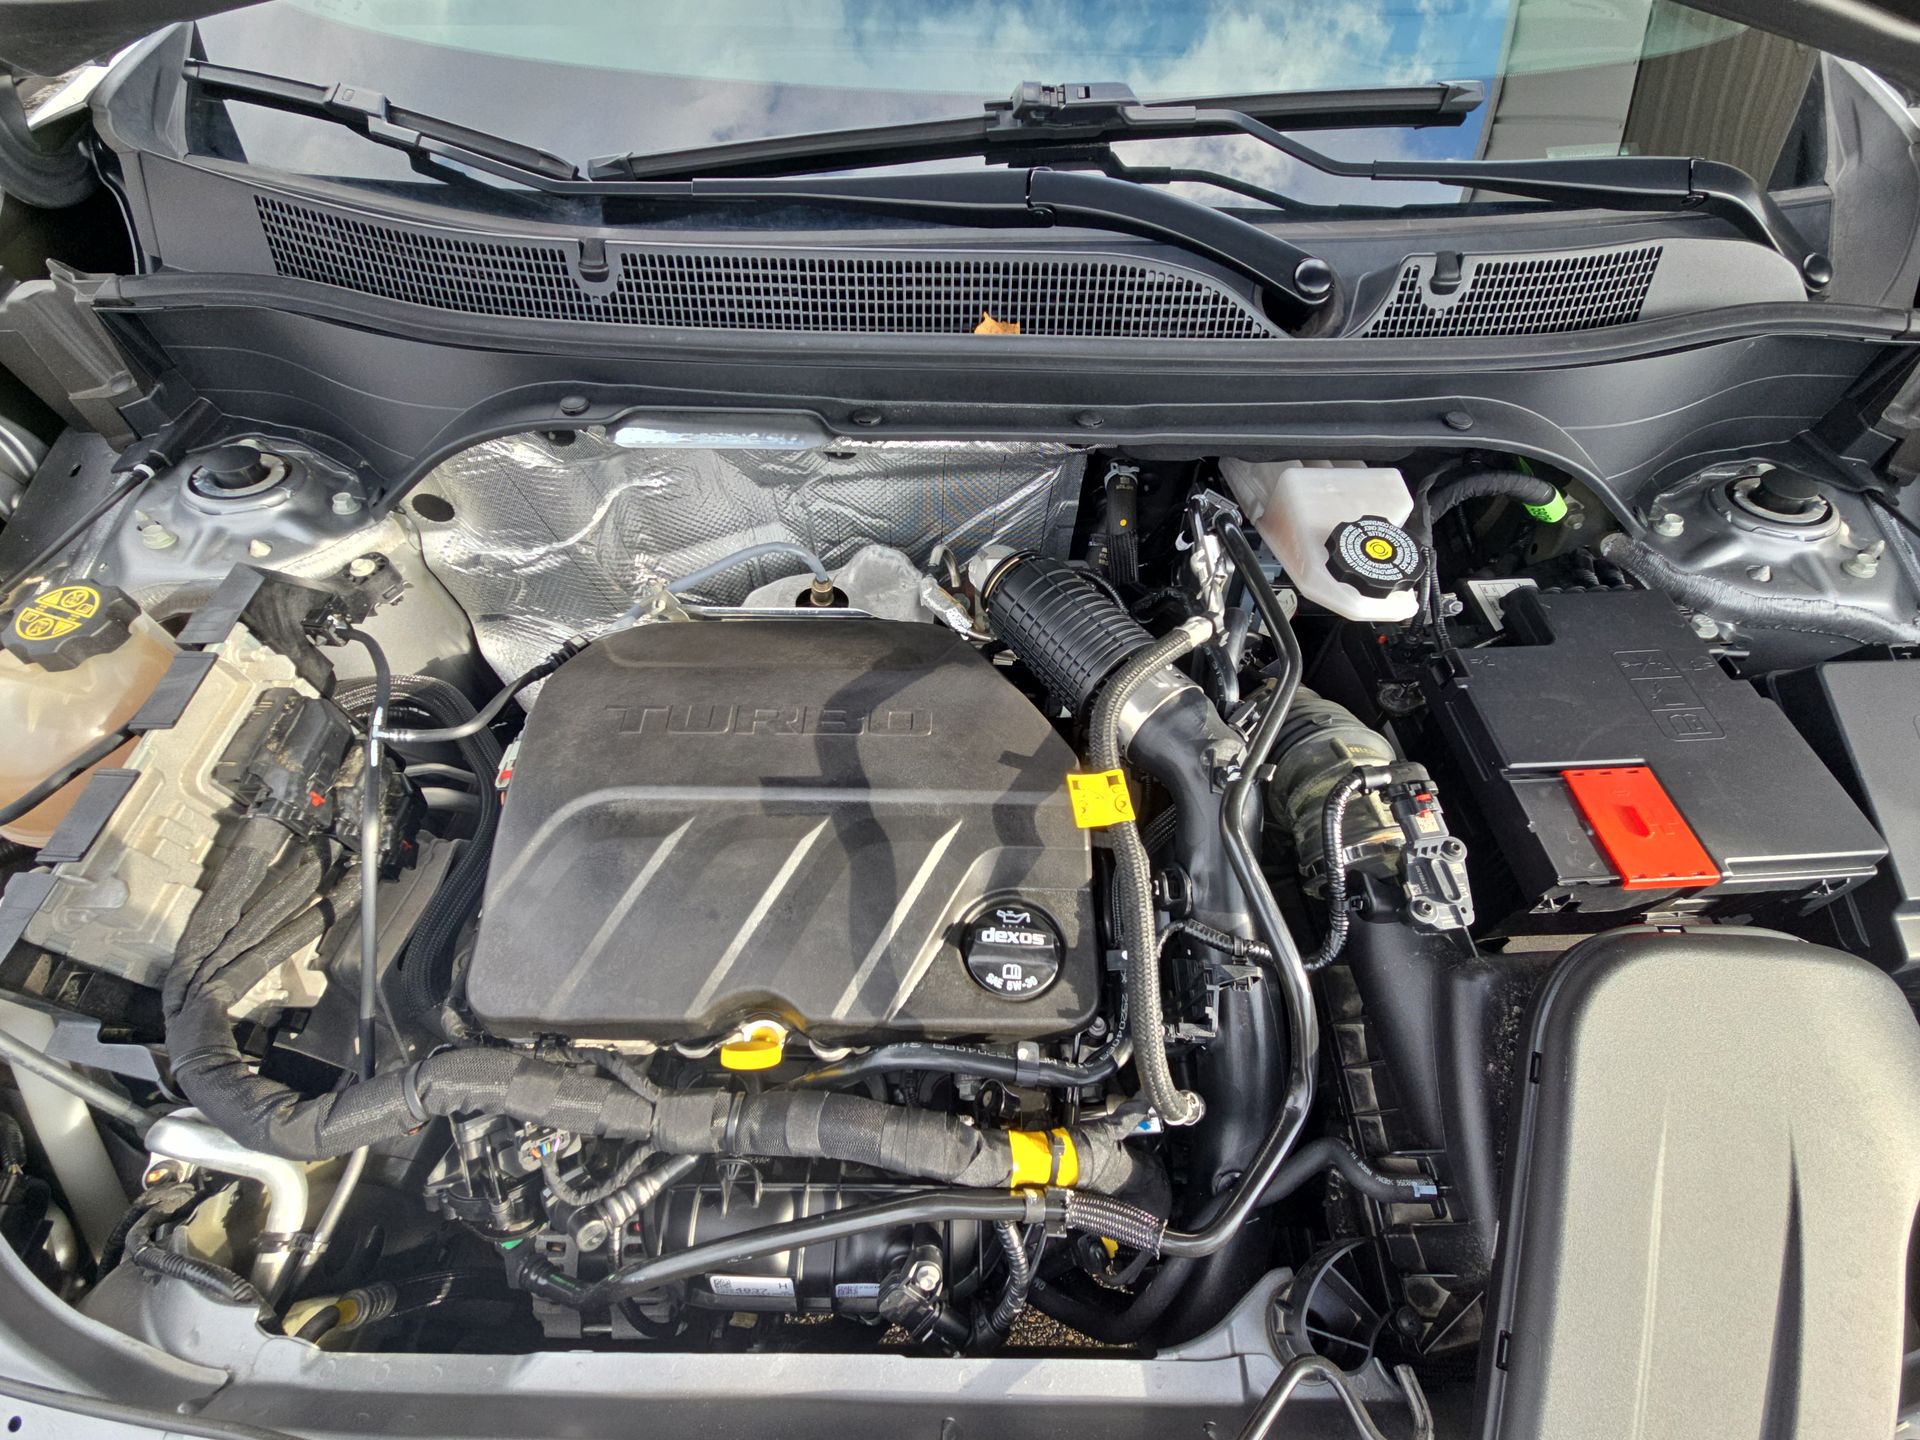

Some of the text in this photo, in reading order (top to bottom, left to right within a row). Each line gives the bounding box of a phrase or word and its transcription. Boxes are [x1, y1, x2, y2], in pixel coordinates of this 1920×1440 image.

[604, 704, 933, 737] TURBO
[981, 926, 1047, 946] dexos
[985, 973, 1038, 991] SAE 5W-30
